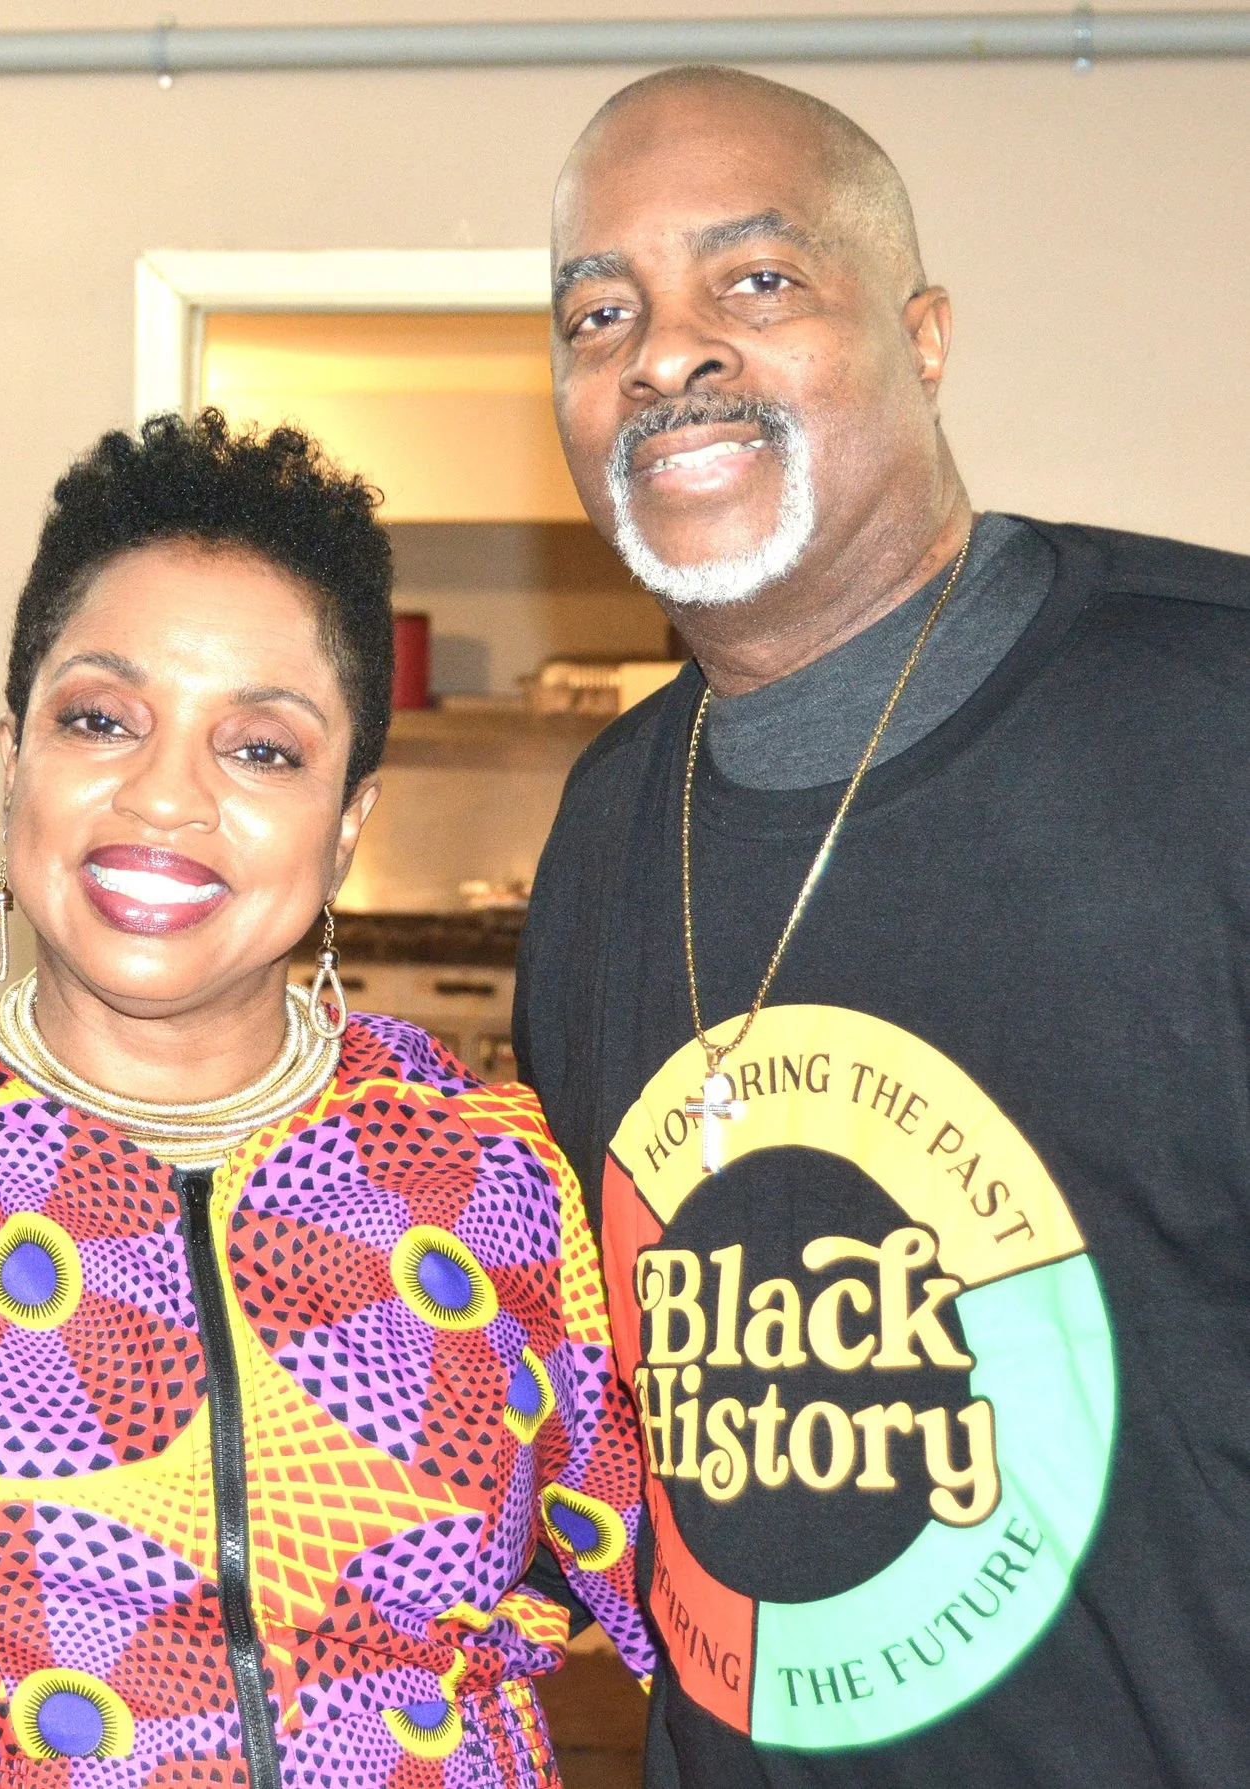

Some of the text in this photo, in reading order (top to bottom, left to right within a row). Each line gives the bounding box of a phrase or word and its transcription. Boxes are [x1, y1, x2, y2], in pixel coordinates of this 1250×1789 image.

[644, 1052, 1036, 1245] HORING THE PAST
[636, 1227, 974, 1371] Black
[634, 1363, 1000, 1525] History
[653, 1504, 1044, 1708] SPIRING THE FUTURE
